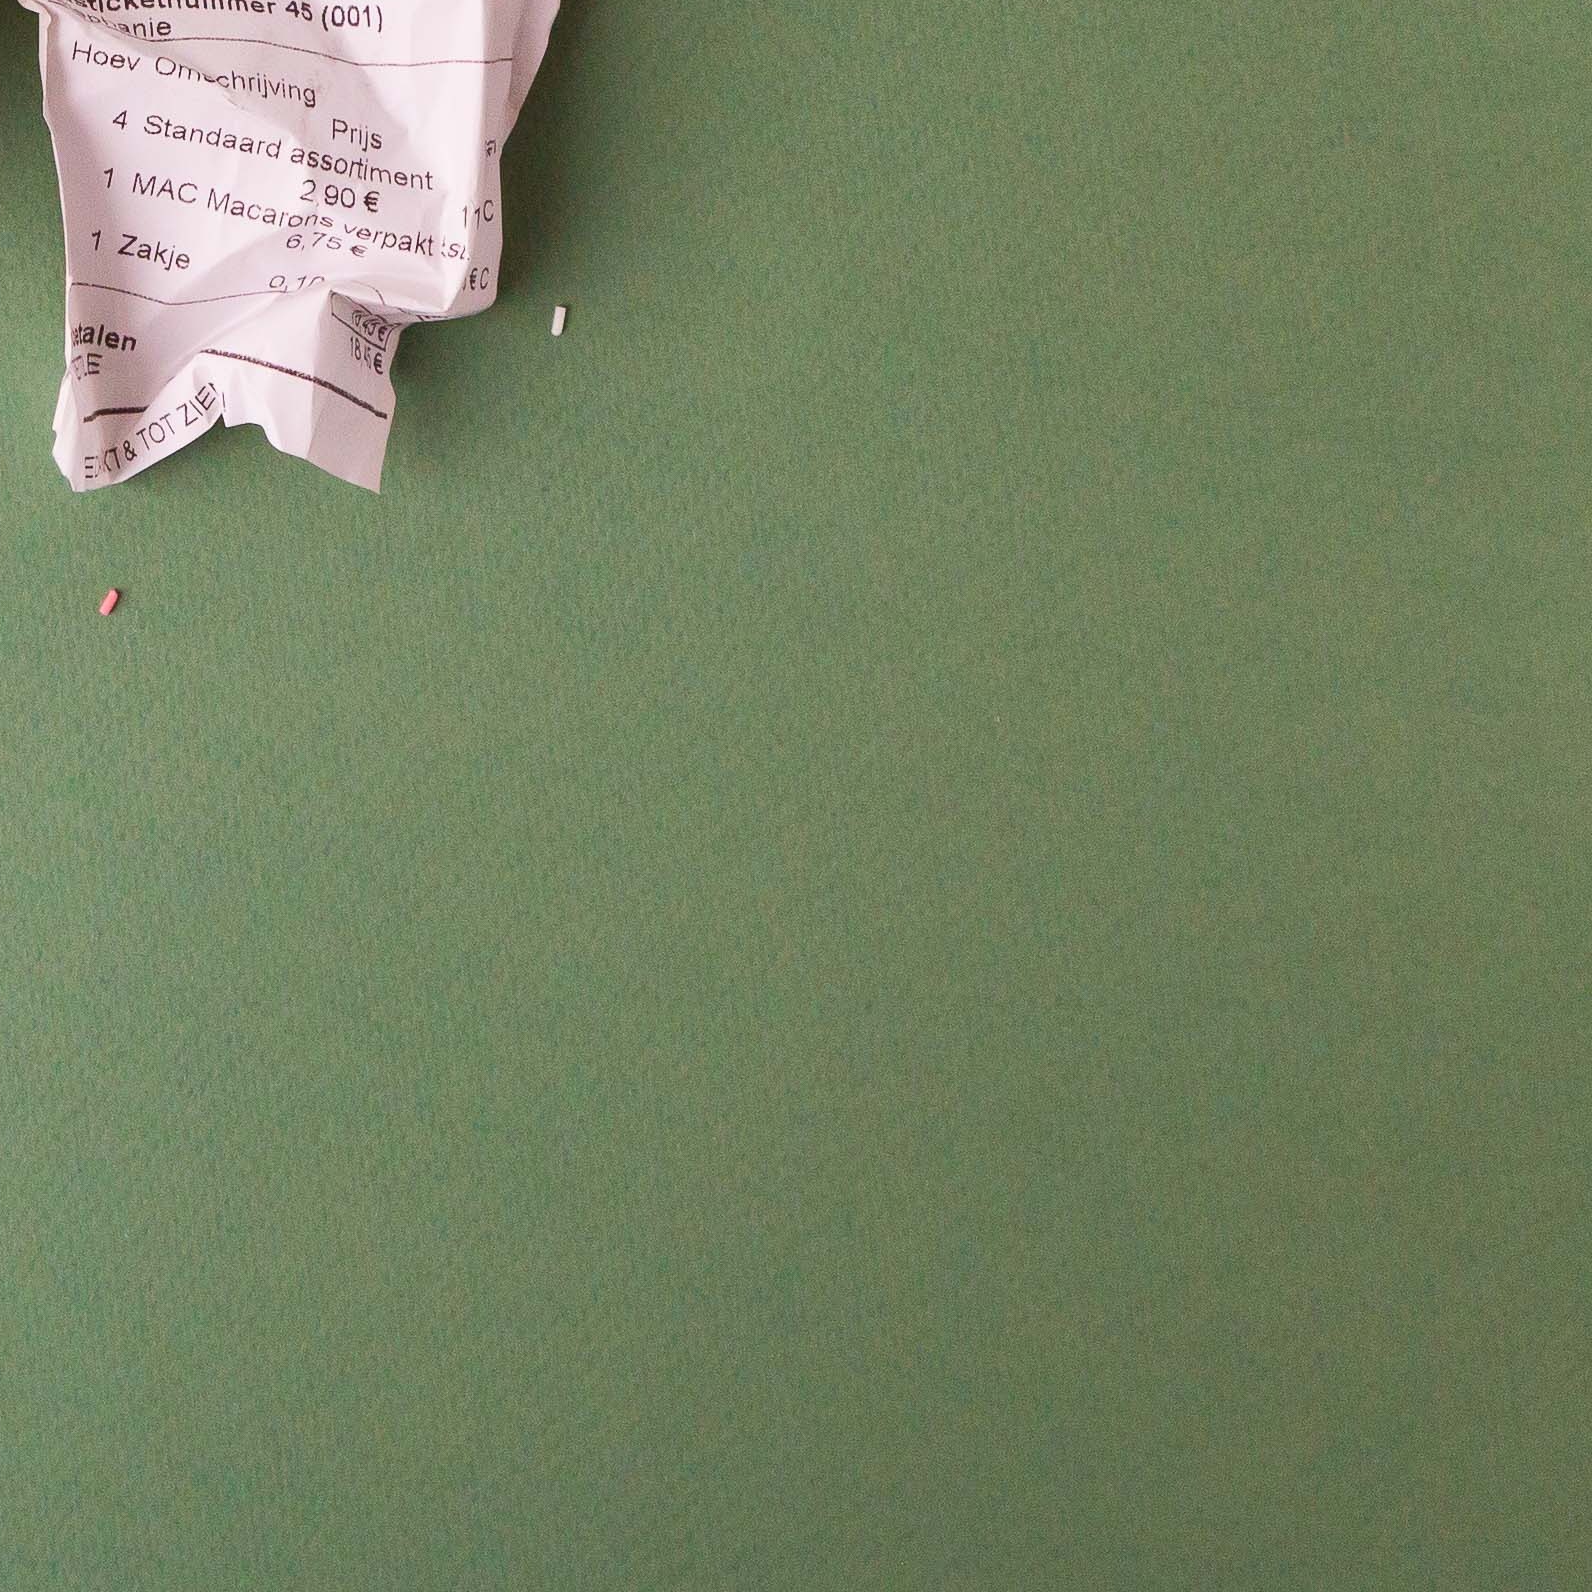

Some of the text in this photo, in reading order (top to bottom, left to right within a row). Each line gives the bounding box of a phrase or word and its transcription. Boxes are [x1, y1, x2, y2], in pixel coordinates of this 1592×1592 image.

[285, 0, 314, 21] 45
[321, 4, 384, 33] (001)
[71, 40, 141, 72] Hoev
[112, 109, 128, 130] 4
[143, 114, 282, 159] Standaard
[290, 147, 434, 191] assortiment
[332, 118, 383, 152] Prijs
[103, 167, 114, 188] 1
[132, 172, 199, 204] MAC
[207, 188, 334, 230] Macarons
[343, 223, 436, 259] verpakt
[299, 179, 381, 213] 2,90 €
[91, 230, 191, 271] 1 Zakje
[286, 231, 343, 252] 6,75
[135, 413, 176, 451] TOT
